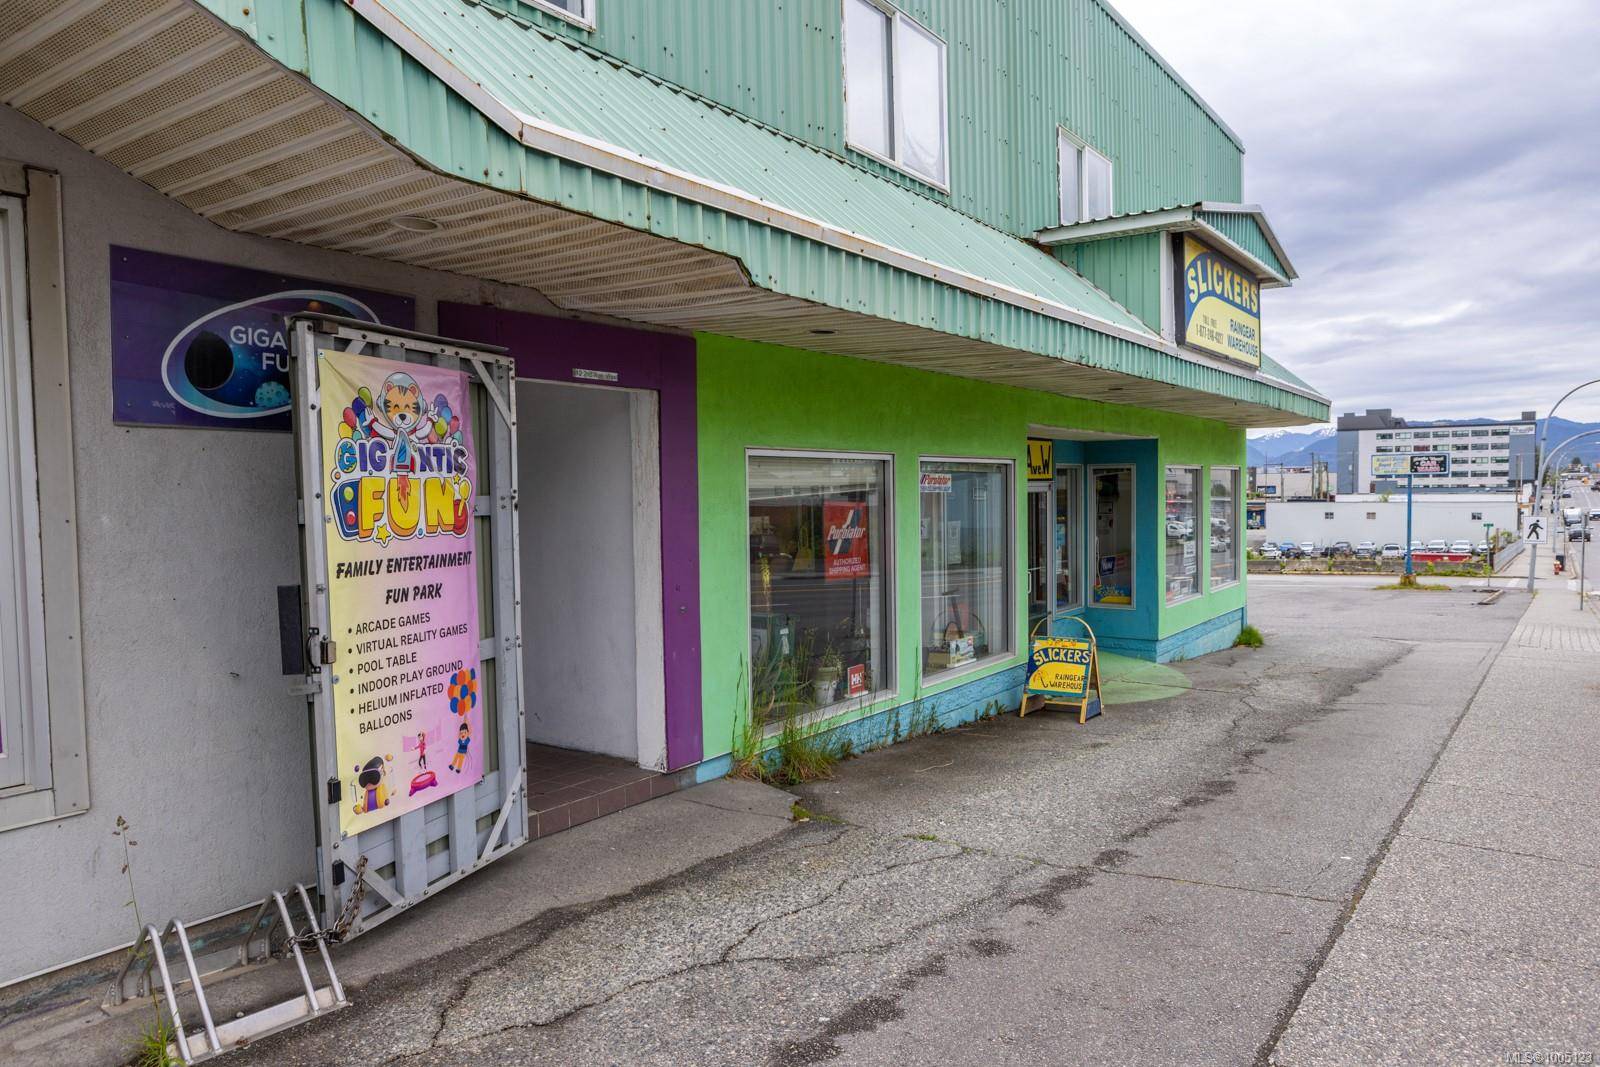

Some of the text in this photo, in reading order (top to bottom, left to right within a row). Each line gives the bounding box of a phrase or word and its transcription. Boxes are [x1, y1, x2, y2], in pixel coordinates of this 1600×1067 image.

[1187, 258, 1257, 314] SLICKERS
[1229, 318, 1256, 341] RAINGEAR
[1226, 334, 1259, 358] WAREHOUSE
[359, 477, 457, 539] FUN
[828, 525, 866, 541] Purolator
[336, 551, 473, 579] FAMILY ENTERTAINMENT
[833, 557, 862, 566] AUTHORIZED
[851, 564, 866, 573] AGENT
[385, 583, 443, 605] FUN PARK
[355, 612, 431, 636] ARCADE GAMES
[356, 623, 469, 655] VIRTUAL REALITY GAMES
[357, 652, 418, 675] POOL TABLE
[1033, 647, 1091, 666] SLICKERS
[358, 660, 464, 695] INDOOR PLAY GROUND
[358, 682, 444, 715] HELIUM INFLATED
[359, 709, 413, 734] BALLOONS
